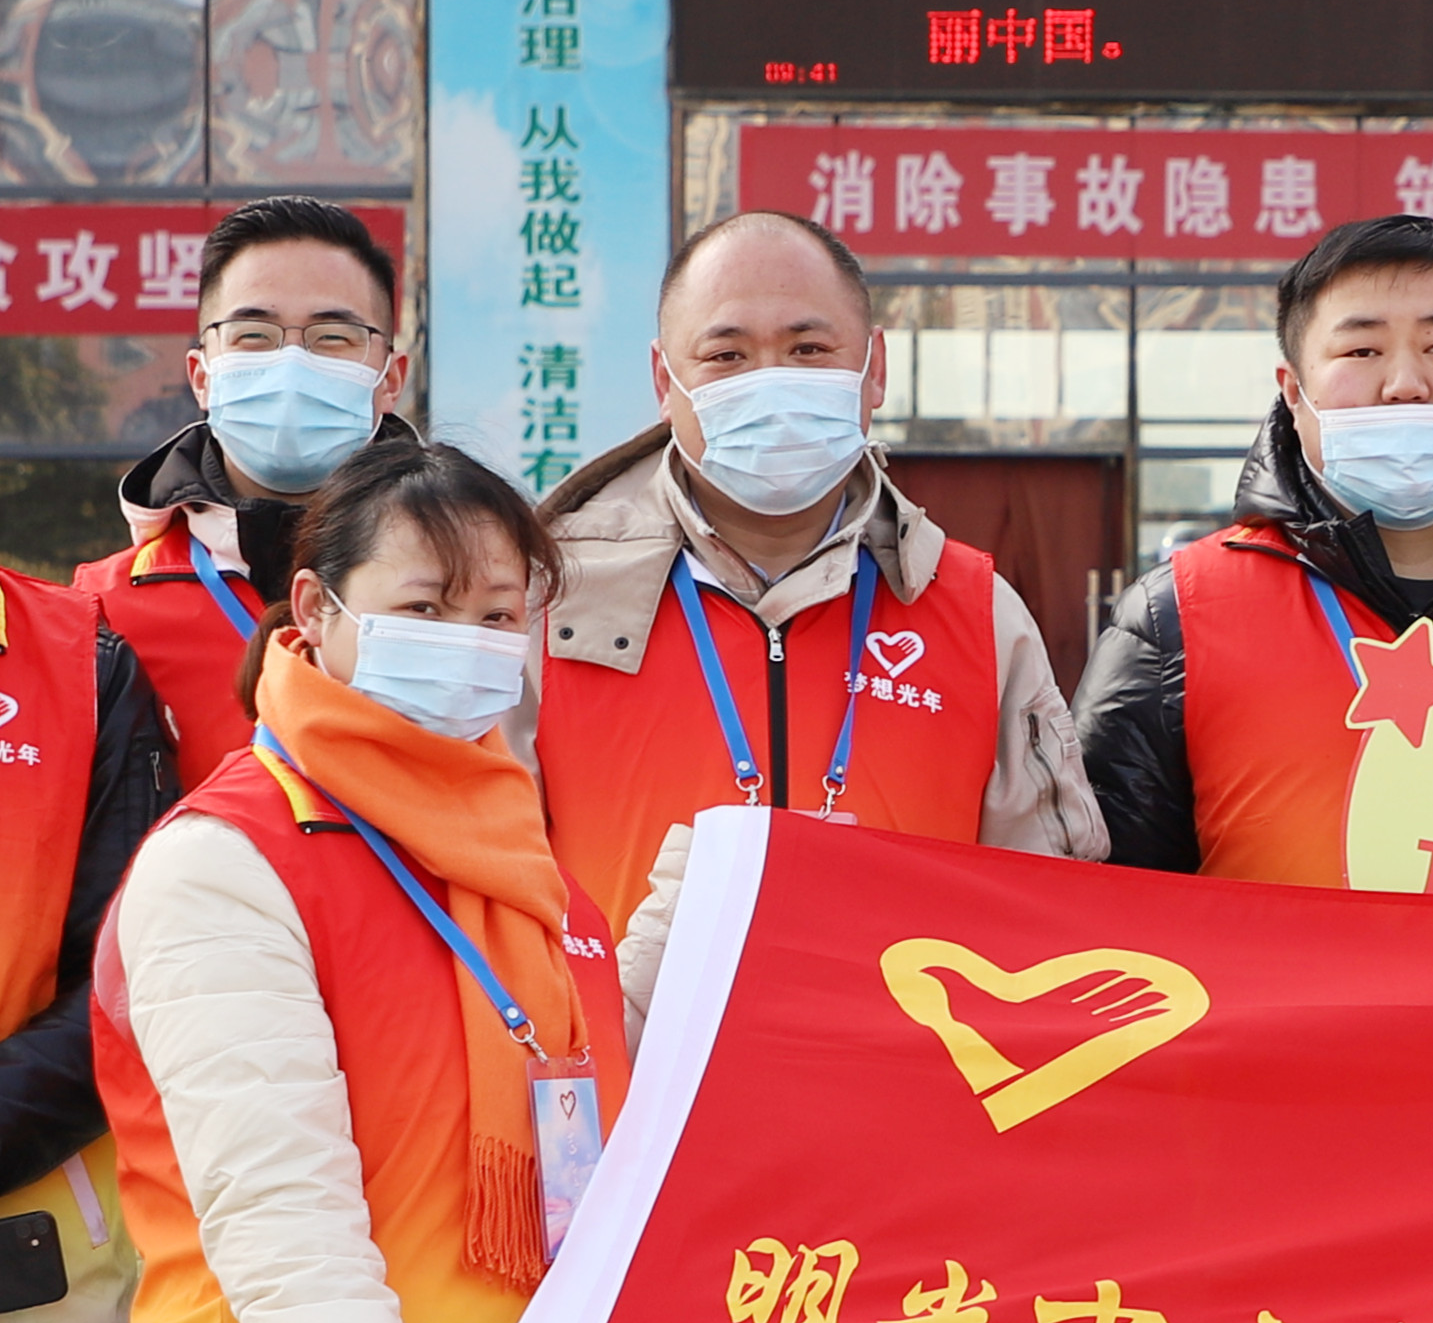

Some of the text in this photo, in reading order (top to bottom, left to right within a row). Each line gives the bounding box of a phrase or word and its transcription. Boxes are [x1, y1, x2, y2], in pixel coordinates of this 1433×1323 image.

[518, 106, 582, 310] 从我做起
[808, 149, 1325, 239] 消除事故隐患
